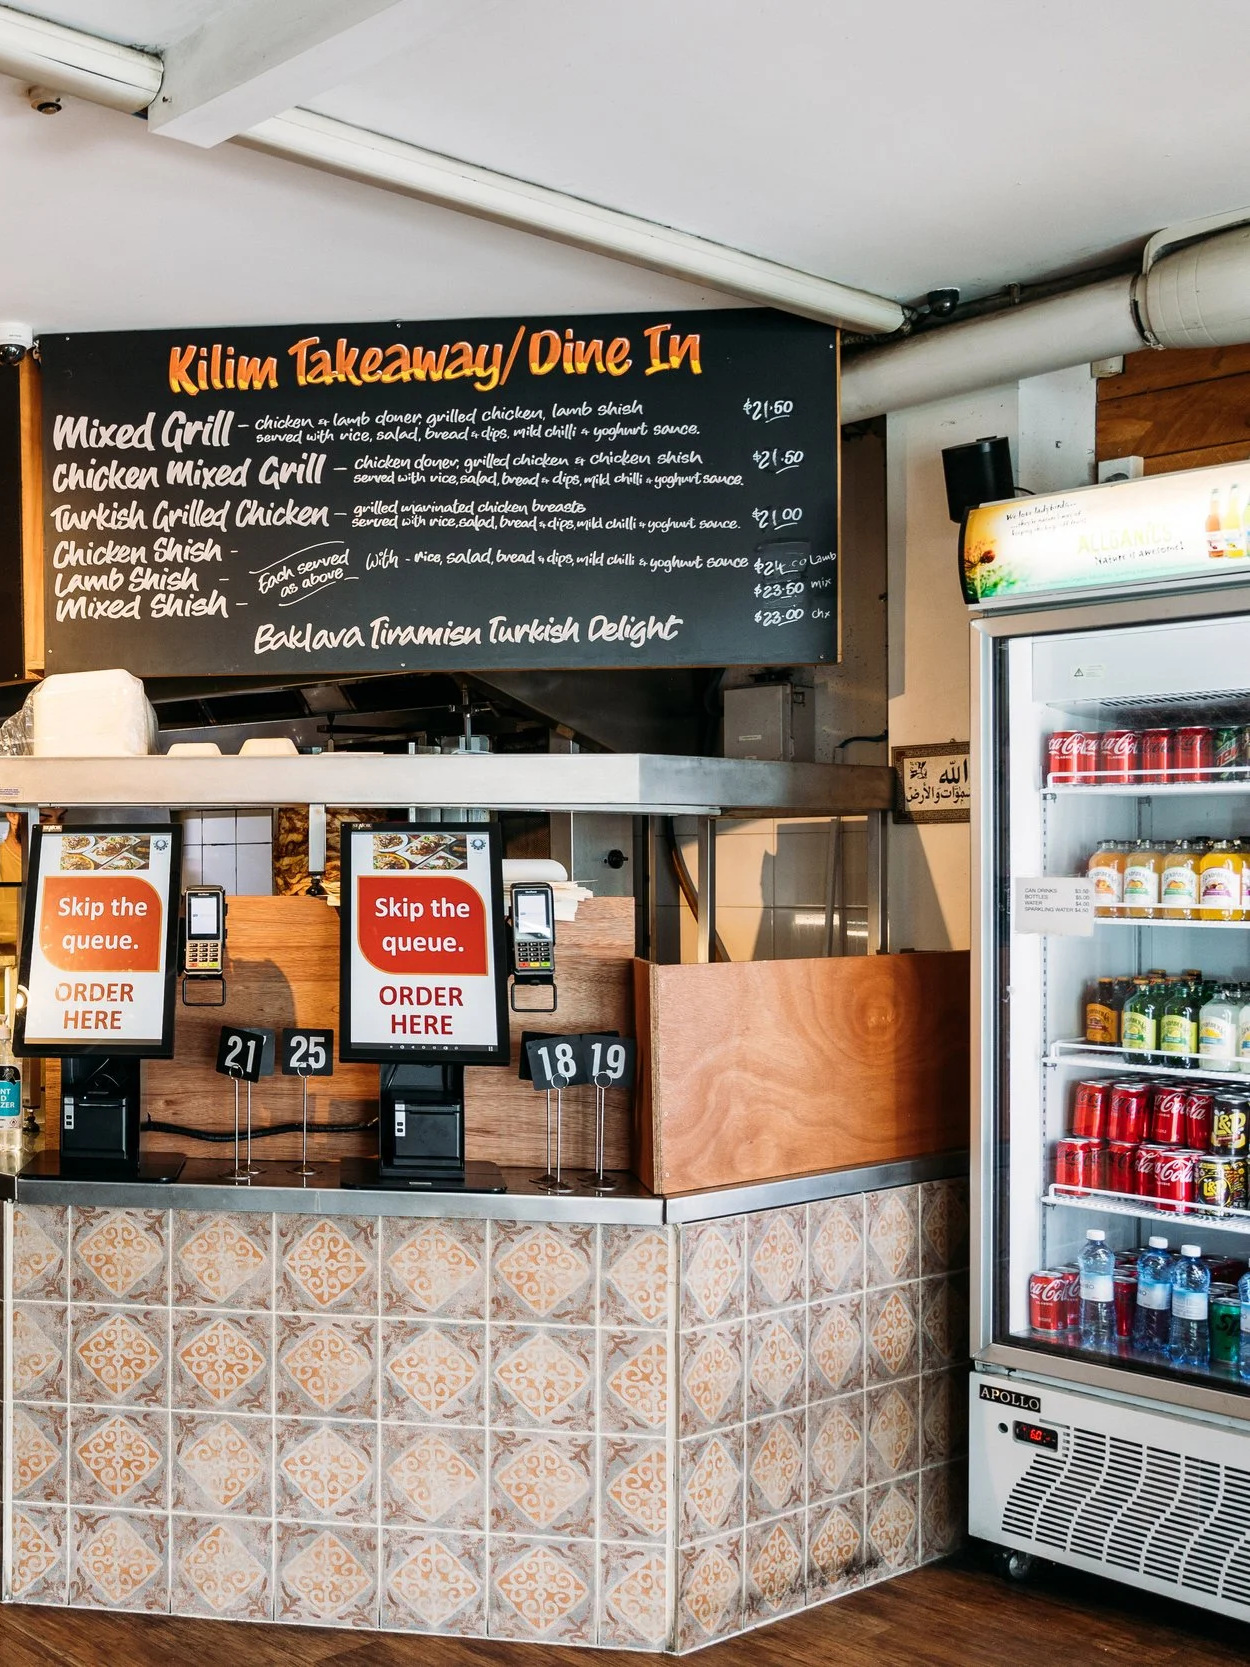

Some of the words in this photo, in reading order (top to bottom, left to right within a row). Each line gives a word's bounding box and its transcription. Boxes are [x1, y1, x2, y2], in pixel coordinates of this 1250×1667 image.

[169, 344, 279, 395] Kilim
[643, 323, 703, 375] In
[53, 411, 156, 451] Mixed
[161, 410, 235, 453] Grill
[255, 414, 315, 431] chicken
[332, 413, 370, 426] lamb
[374, 410, 422, 426] doner,
[426, 406, 477, 429] grilled
[481, 405, 546, 421] chicken,
[552, 403, 593, 418] lamb
[597, 400, 644, 416] shish
[255, 429, 302, 444] served
[305, 427, 334, 442] with
[337, 428, 374, 444] rice,
[376, 426, 422, 443] salad,
[424, 426, 469, 441] bread
[513, 424, 542, 438] mild
[544, 424, 577, 440] chilli
[593, 422, 648, 442] yoghurt
[653, 424, 701, 437] sauce.
[52, 459, 160, 493] Chicken
[166, 457, 251, 490] Mixed
[258, 453, 327, 490] Grill
[354, 454, 411, 471] chicken
[413, 455, 460, 471] doner,
[464, 452, 510, 472] grilled
[513, 452, 570, 467] chicken
[590, 450, 651, 466] chicken
[657, 449, 704, 466] shish
[354, 471, 395, 485] served
[398, 471, 426, 484] with
[501, 472, 540, 487] bread
[584, 473, 611, 488] mild
[614, 472, 643, 486] chilli
[654, 472, 701, 489] yoghurt
[702, 473, 745, 486] sauce.
[50, 499, 148, 532] Turkish
[151, 498, 229, 532] Grilled
[235, 498, 330, 528] Chicken
[353, 499, 398, 517] grilled
[400, 500, 474, 515] marinated
[477, 501, 529, 516] chicken
[532, 502, 587, 515] breasts
[52, 540, 148, 569] Chicken
[153, 537, 223, 563] Shish
[365, 547, 399, 570] with
[414, 551, 443, 566] rice,
[446, 547, 494, 566] salad,
[496, 549, 536, 564] bread
[576, 551, 605, 567] mild
[607, 553, 635, 567] chilli
[648, 555, 703, 573] yoghurt
[705, 556, 749, 568] sauce
[809, 551, 837, 566] Lamb
[54, 569, 125, 597] Lamb
[128, 566, 200, 594] Shish
[257, 570, 295, 594] Each
[297, 548, 350, 576] served
[280, 581, 298, 598] as
[300, 566, 345, 588] above
[754, 581, 805, 599] $23.50
[810, 577, 832, 589] mix
[55, 594, 141, 621] Mixed
[150, 589, 230, 619] Shish
[754, 609, 805, 626] $23.00
[254, 622, 366, 654] Baklava
[370, 616, 481, 649] Tiramisu
[489, 615, 581, 646] Turkish
[588, 615, 683, 649] Delight
[58, 896, 105, 922] Skip
[111, 897, 148, 918] the
[375, 896, 424, 922] Skip
[429, 897, 470, 918] the
[62, 930, 139, 955] queue.
[382, 932, 465, 956] queue.
[55, 982, 134, 1003] ORDER
[379, 985, 464, 1007] ORDER
[63, 1009, 122, 1031] HERE
[390, 1014, 454, 1036] HERE
[226, 1035, 256, 1073] 21
[290, 1035, 327, 1070] 25
[537, 1043, 577, 1081] 18
[591, 1042, 626, 1079] 19
[1214, 1108, 1246, 1136] L&P
[980, 1387, 1040, 1411] APOLLO
